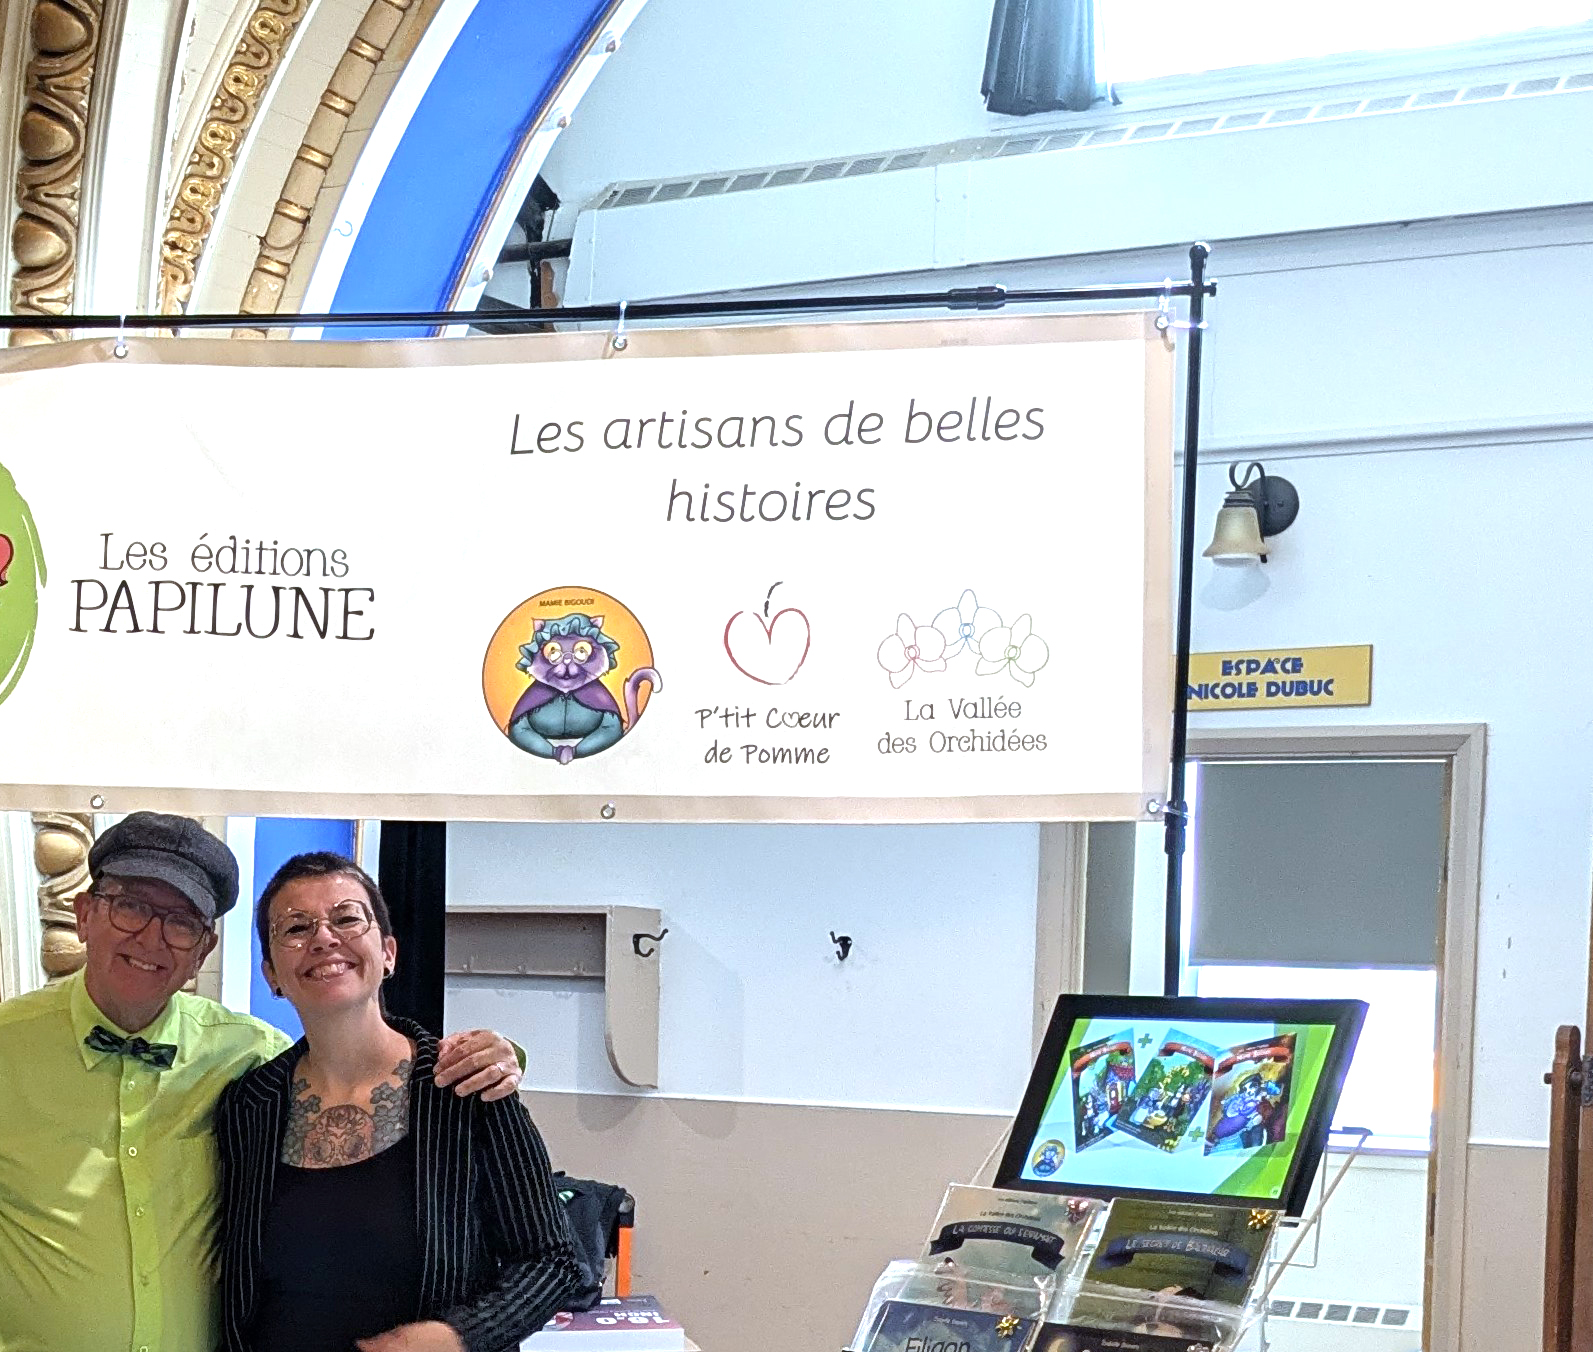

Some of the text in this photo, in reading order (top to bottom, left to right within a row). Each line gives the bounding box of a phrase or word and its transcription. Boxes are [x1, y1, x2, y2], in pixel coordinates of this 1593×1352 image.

[510, 396, 1045, 456] Les artisans de belles
[666, 478, 876, 522] histoires
[99, 532, 349, 578] Les éditions
[69, 578, 375, 641] PAPILUNE
[539, 598, 595, 607] MAMIE BIGOUDI
[1221, 657, 1304, 677] ESPACE
[1186, 678, 1335, 700] NICOLE DUBUC
[695, 706, 757, 729] P'tit
[904, 695, 1022, 721] La Vallée
[704, 739, 830, 764] de Pomme
[877, 728, 1048, 754] des Orchidées
